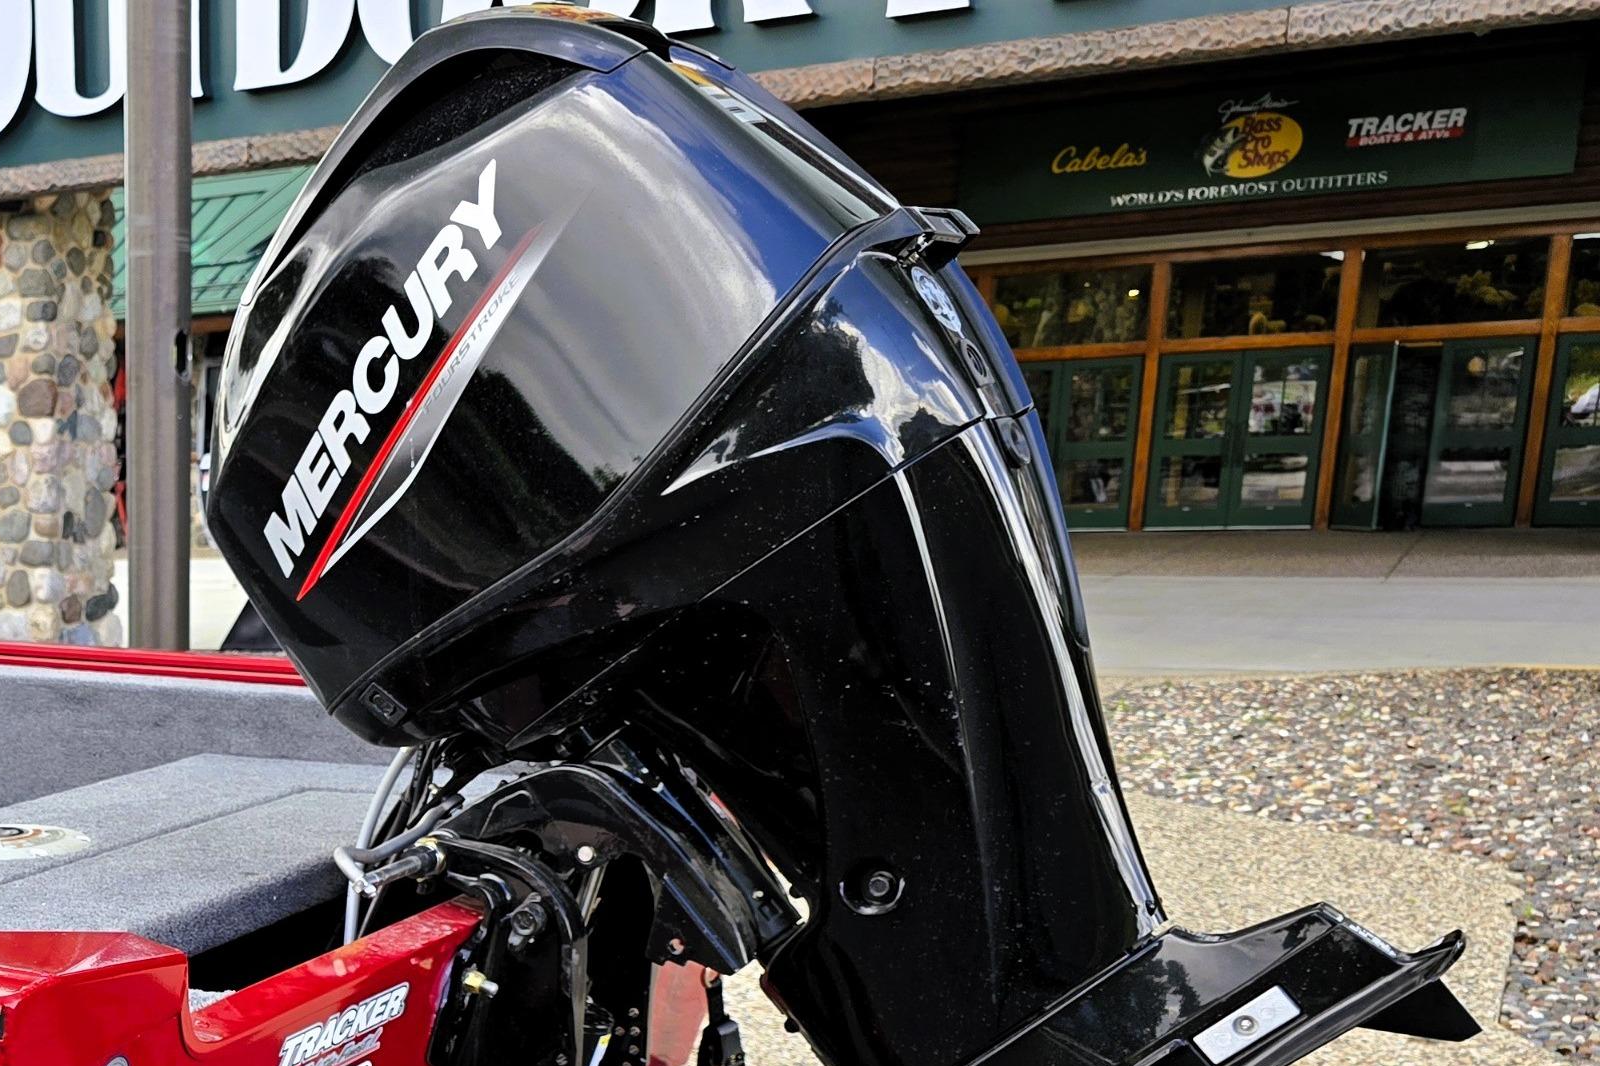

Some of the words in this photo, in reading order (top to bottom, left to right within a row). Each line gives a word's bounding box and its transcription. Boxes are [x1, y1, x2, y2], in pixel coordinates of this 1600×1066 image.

[1240, 115, 1283, 135] Bass
[1347, 107, 1468, 138] TRACKER
[1358, 134, 1400, 147] BOATS
[1404, 133, 1414, 143] &
[1051, 143, 1148, 175] Cabela's
[1237, 147, 1290, 170] Shops
[1110, 188, 1184, 208] WORLD'S
[1187, 180, 1278, 201] FOREMOST
[1281, 170, 1389, 192] OUTFITTERS
[420, 272, 521, 417] FOURSTROKE
[262, 158, 502, 578] MERCURY
